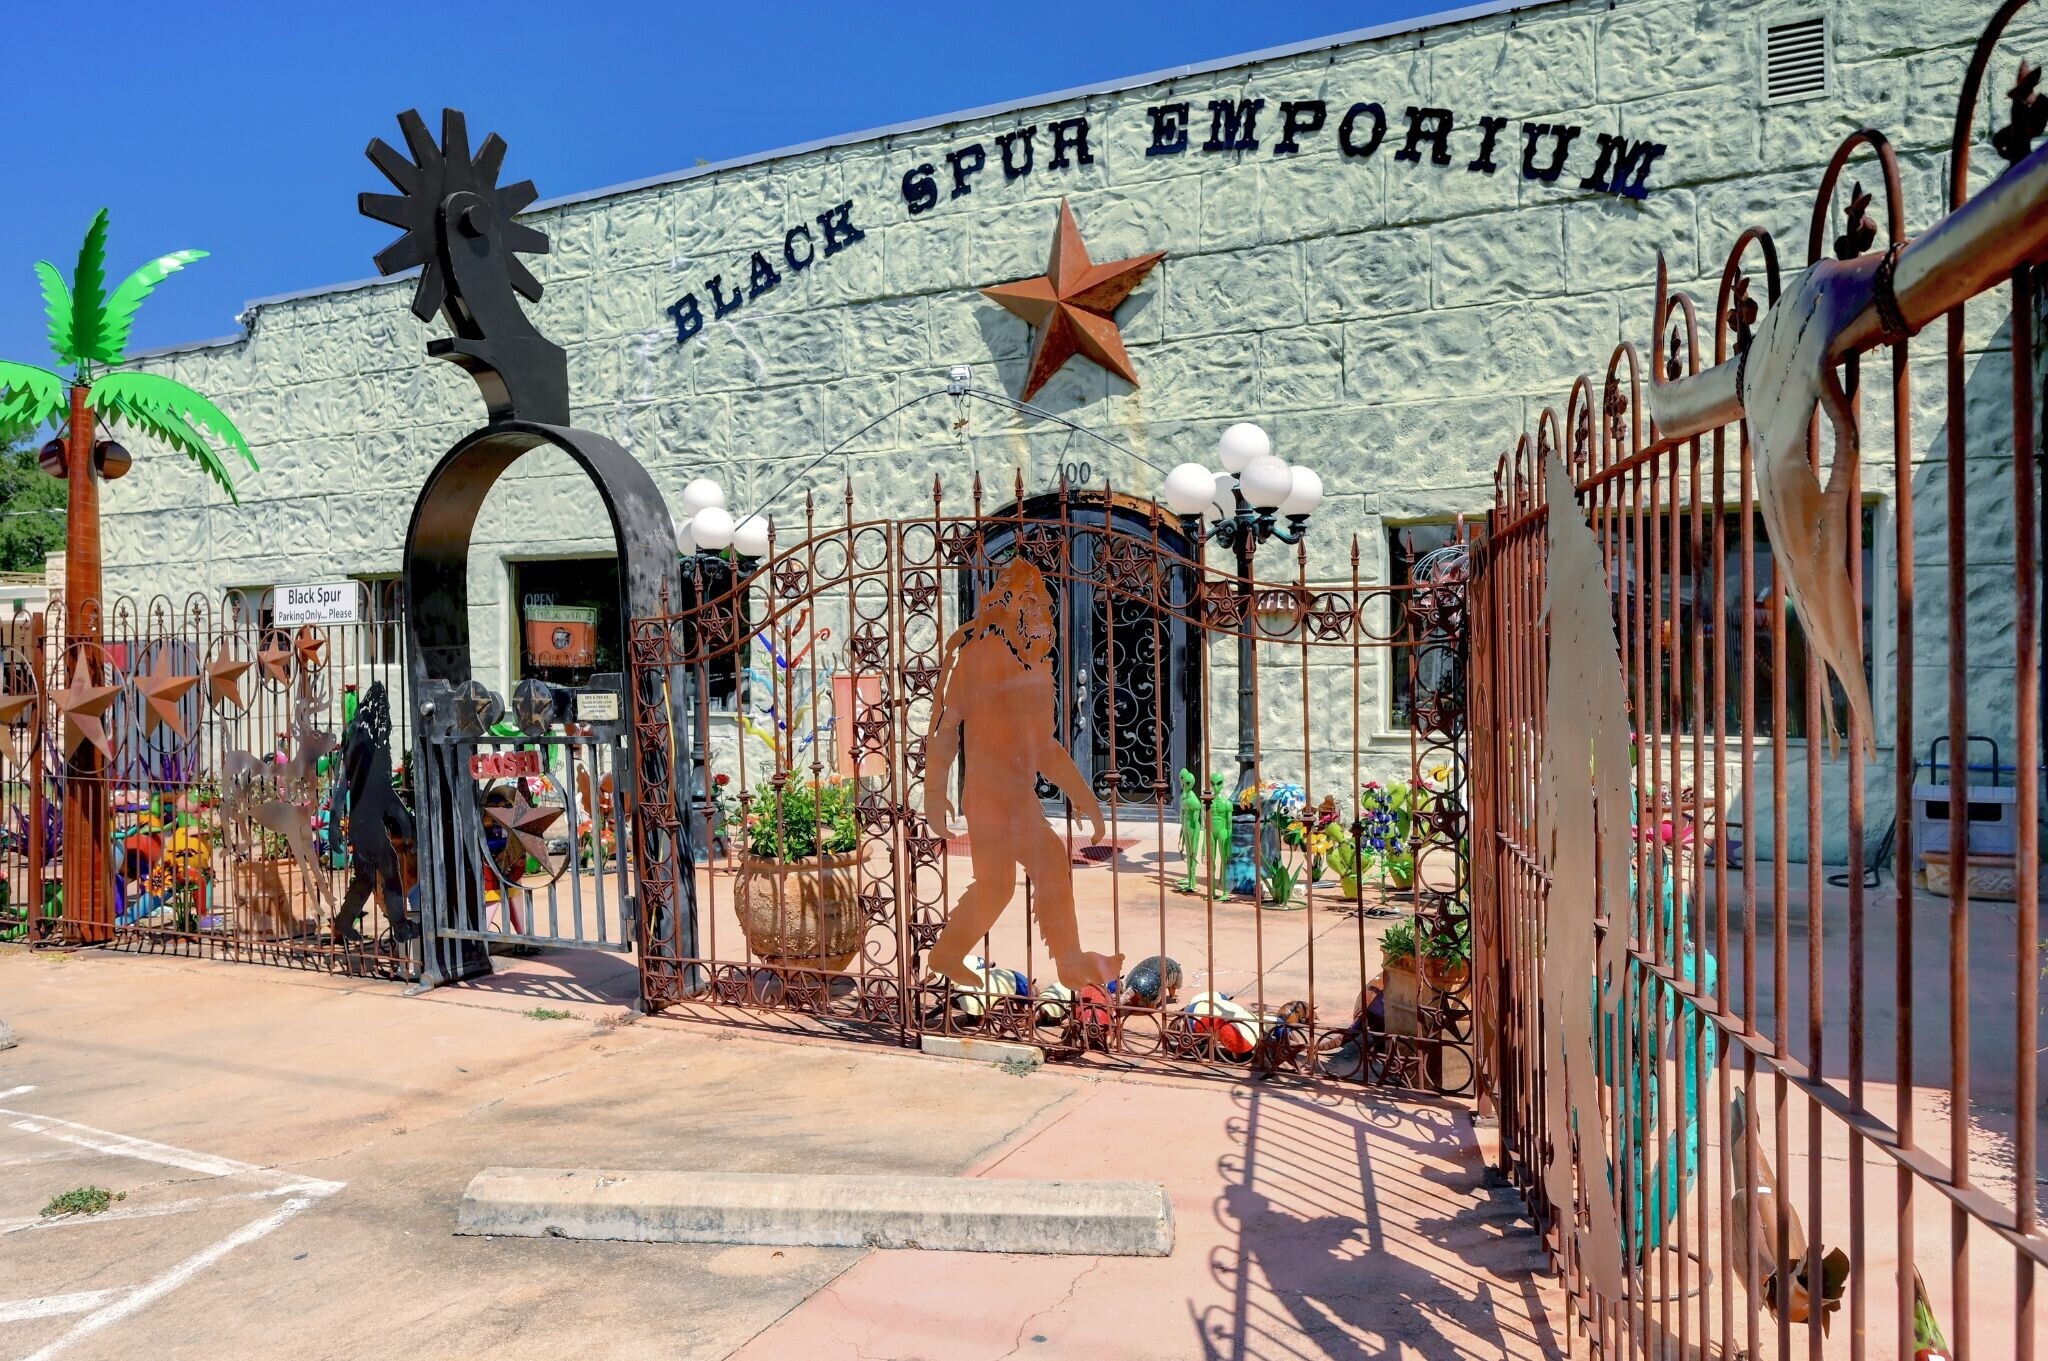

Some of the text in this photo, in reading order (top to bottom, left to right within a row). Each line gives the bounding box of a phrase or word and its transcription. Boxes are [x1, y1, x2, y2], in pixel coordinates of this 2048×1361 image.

[667, 99, 1667, 344] BLACK SPUR EMPORIUM
[288, 587, 342, 607] Black Spur
[523, 593, 554, 609] OPEN
[278, 610, 305, 623] Parking
[328, 607, 353, 620] Please
[469, 751, 542, 780] CLOSED
